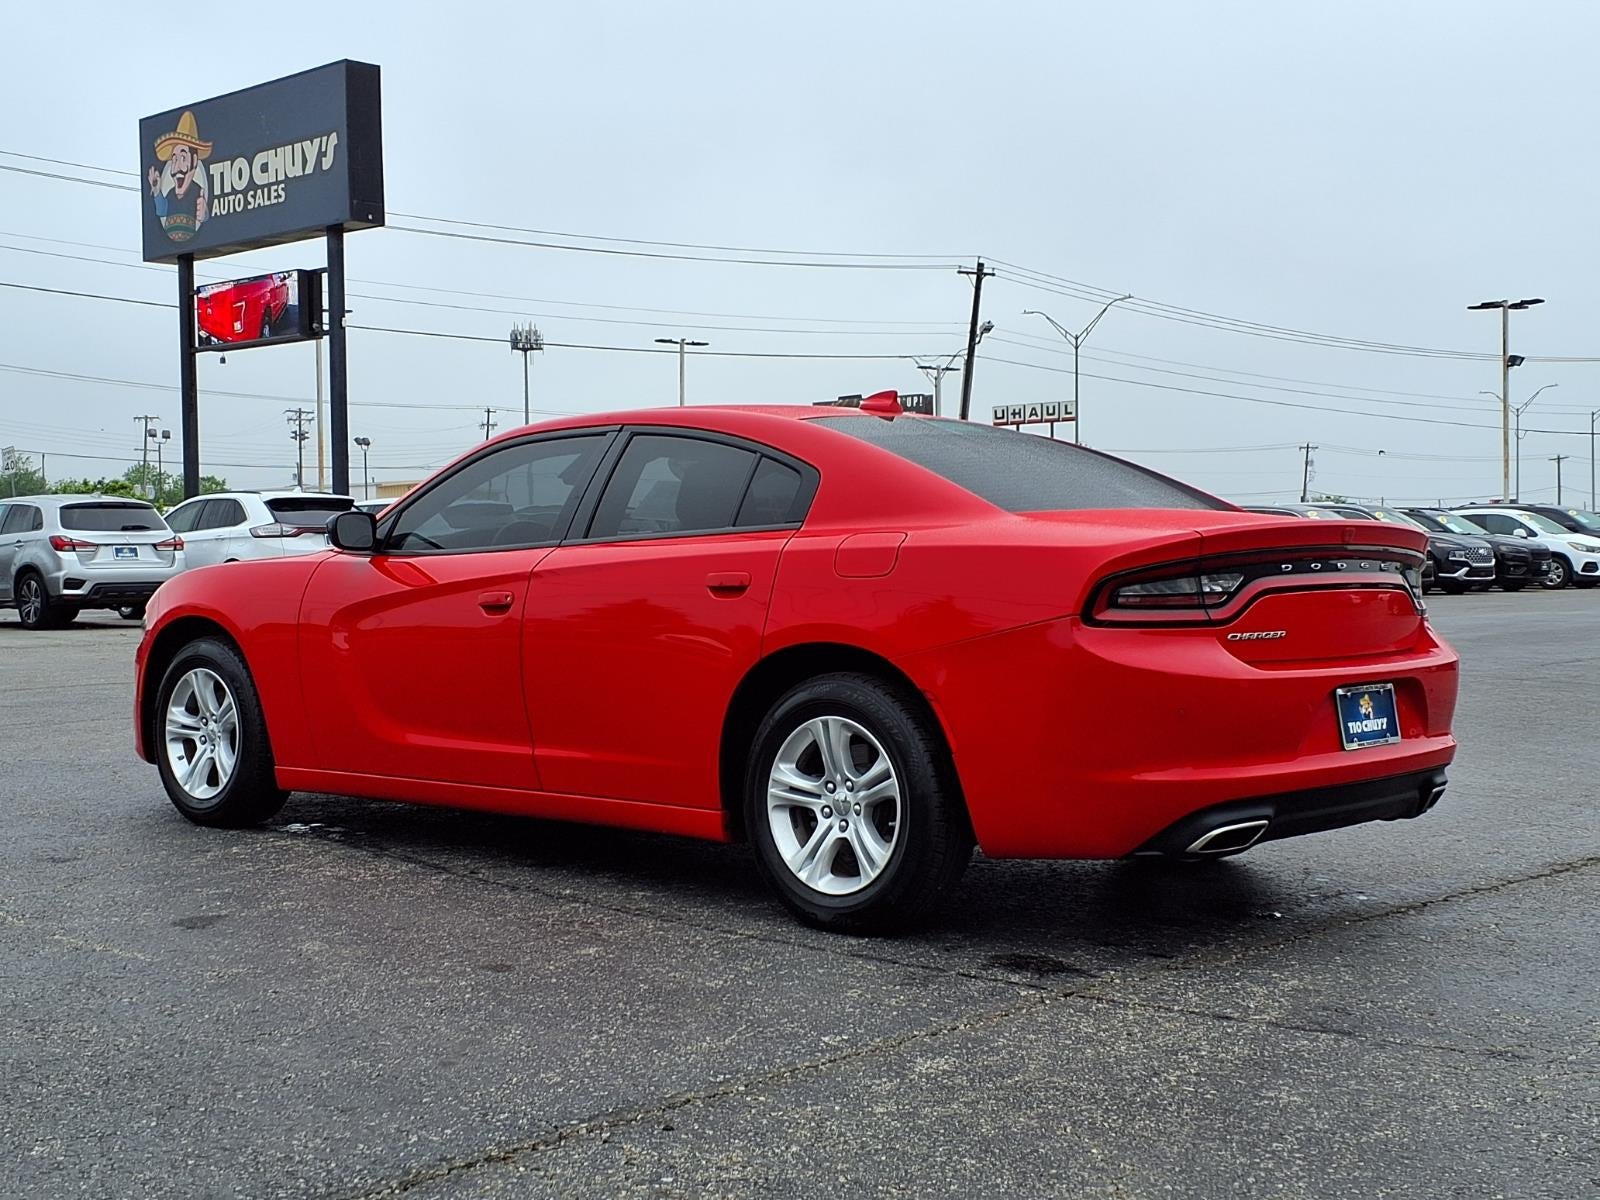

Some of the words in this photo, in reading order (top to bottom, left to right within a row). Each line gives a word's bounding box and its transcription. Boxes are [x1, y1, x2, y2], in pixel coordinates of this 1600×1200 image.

[209, 157, 250, 196] TIO
[252, 131, 338, 185] CHUY'S
[211, 193, 244, 217] AUTO
[247, 183, 286, 210] SALES
[4, 460, 15, 471] 40
[1281, 562, 1390, 572] DODGE
[1227, 630, 1287, 641] CHARGER
[1347, 721, 1362, 734] TIO
